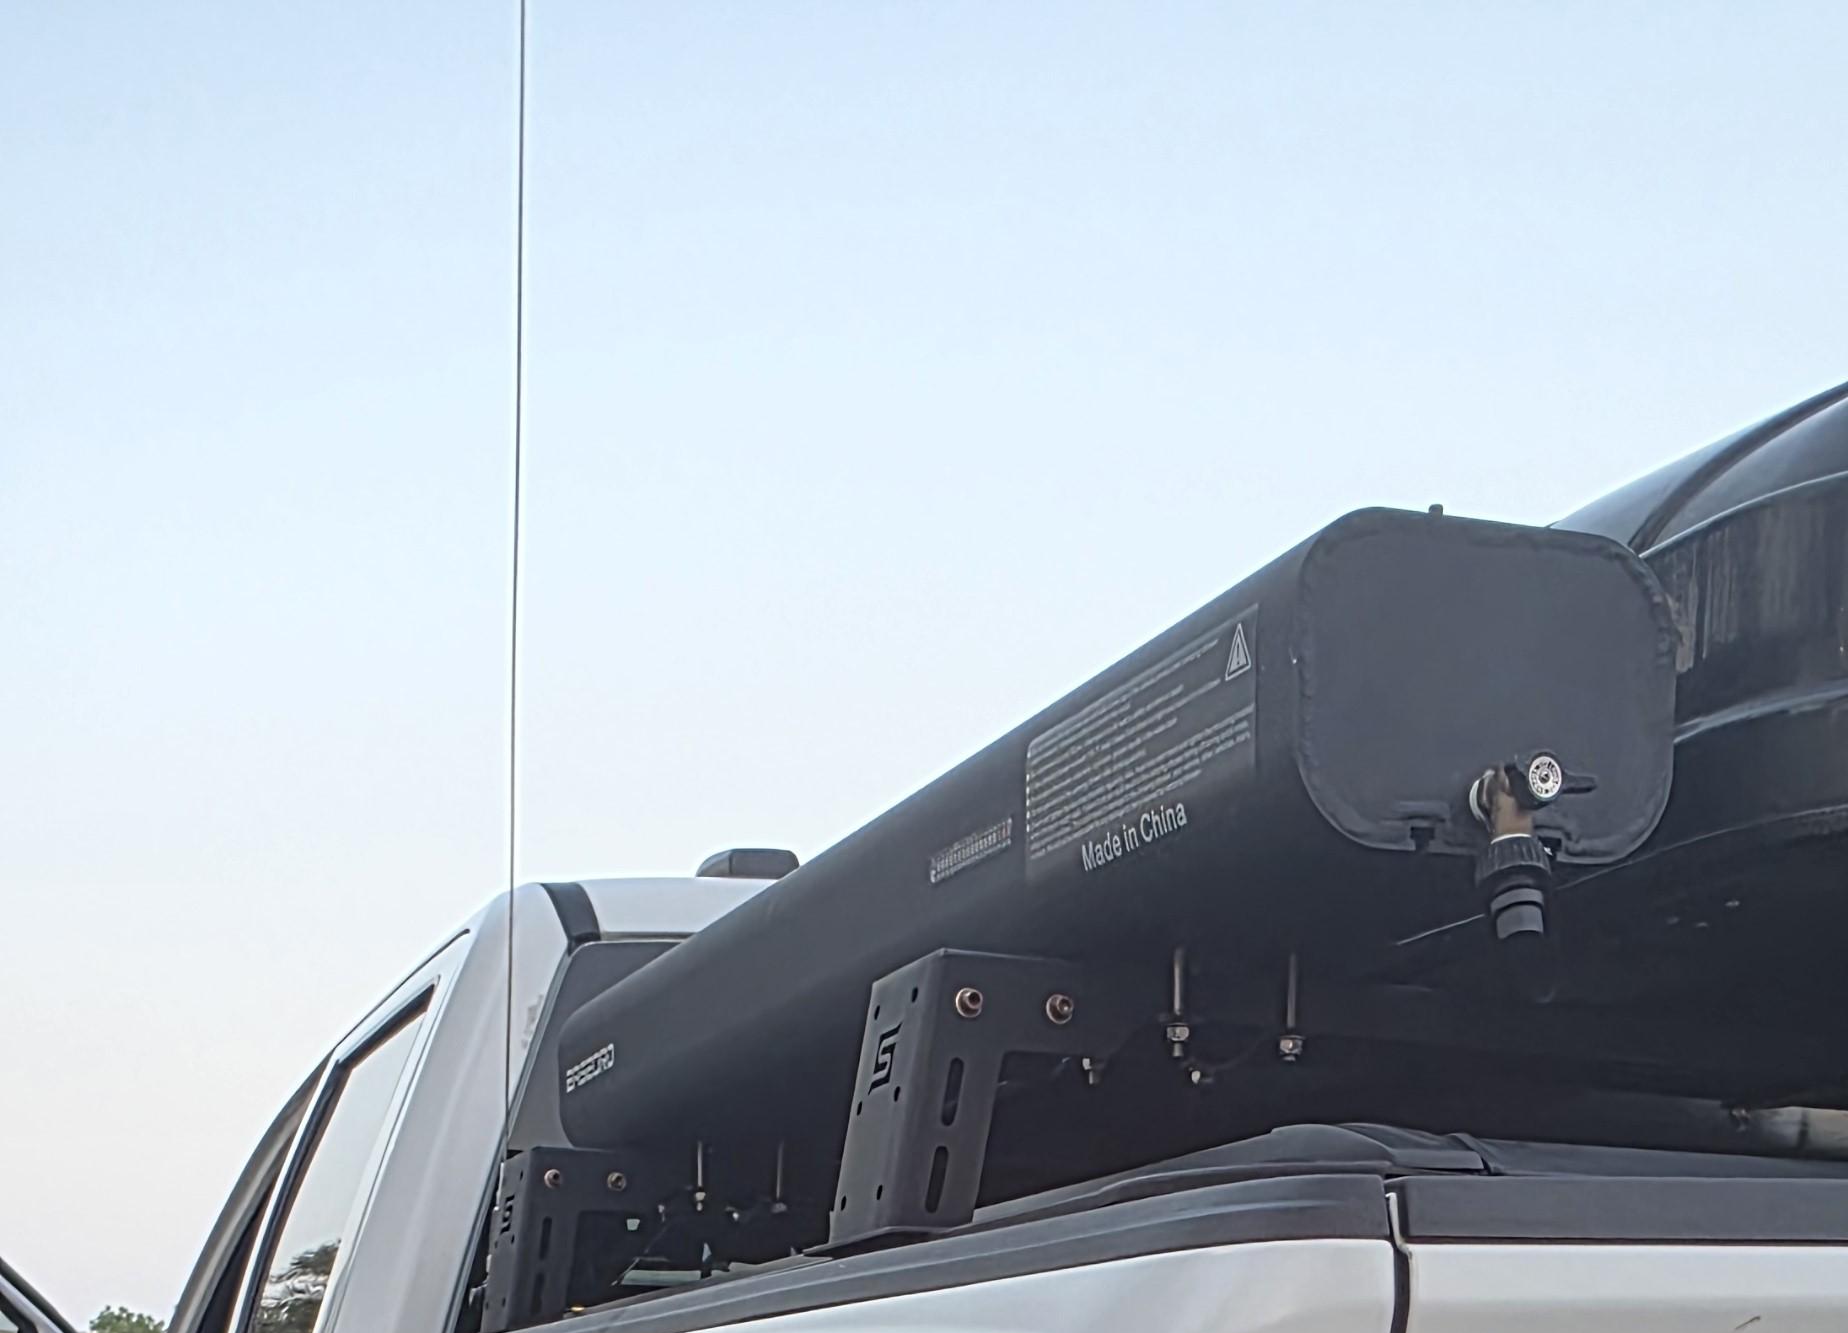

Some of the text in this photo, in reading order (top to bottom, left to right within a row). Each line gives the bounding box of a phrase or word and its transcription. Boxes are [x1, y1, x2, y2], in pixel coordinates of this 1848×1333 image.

[1081, 802, 1187, 871] Made in China
